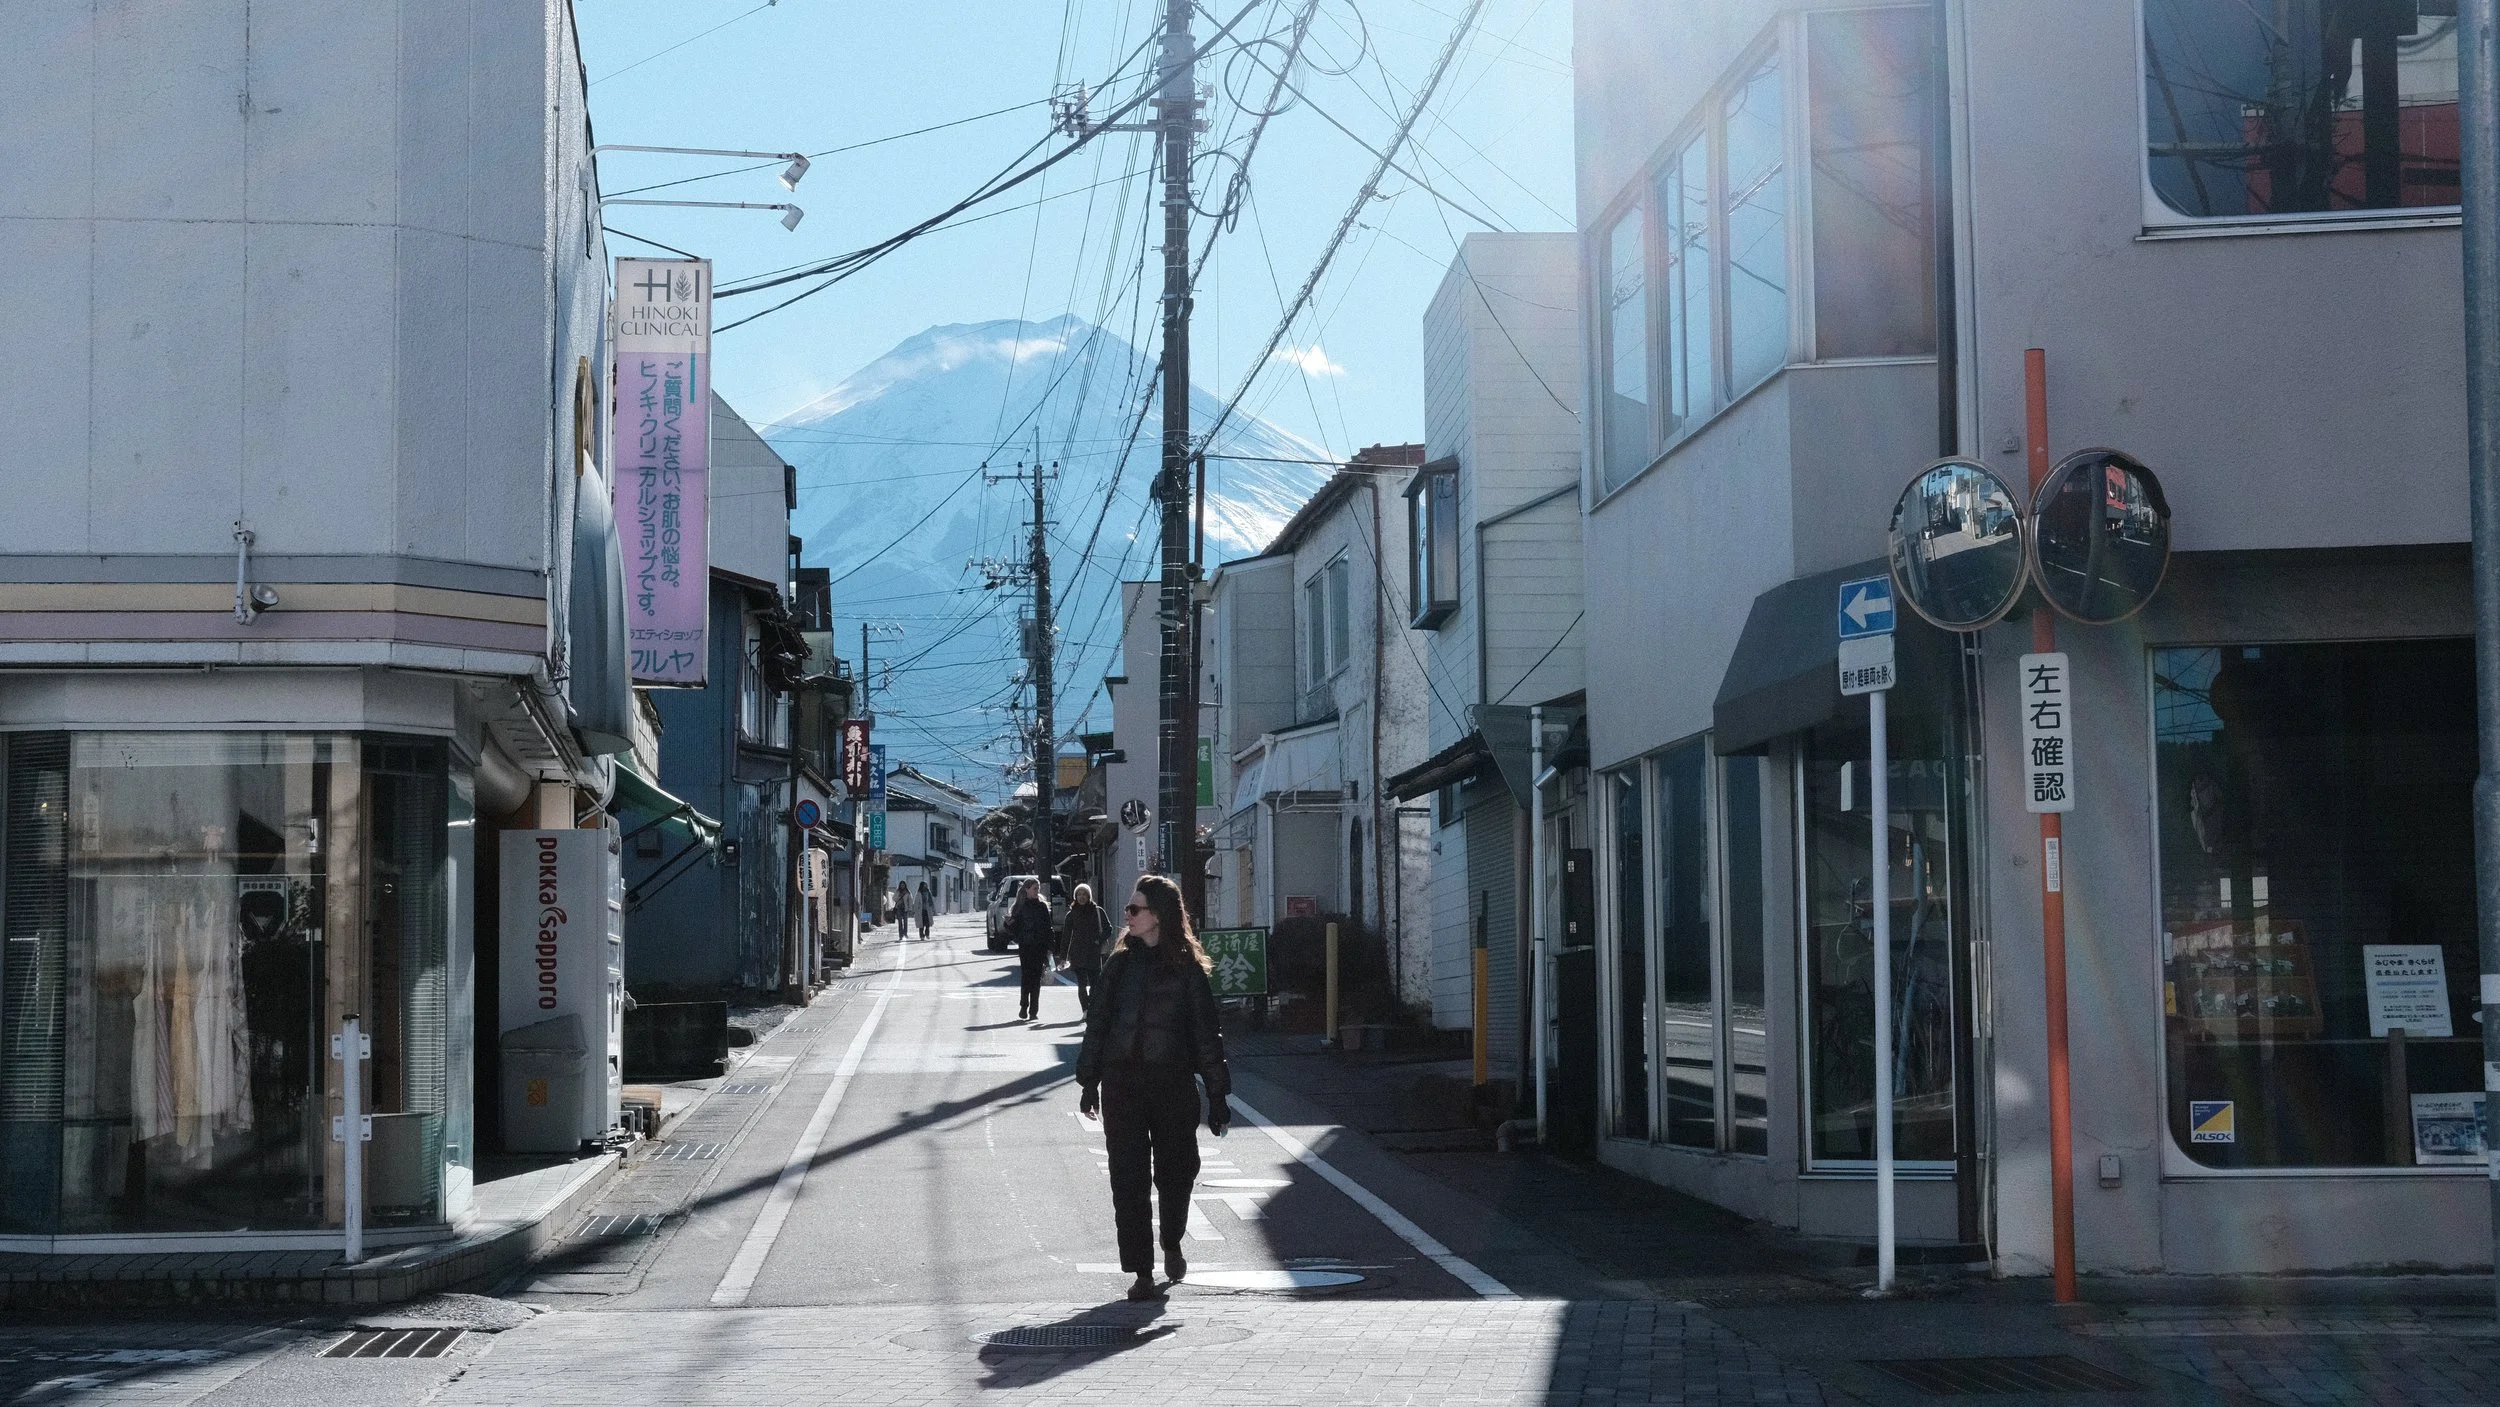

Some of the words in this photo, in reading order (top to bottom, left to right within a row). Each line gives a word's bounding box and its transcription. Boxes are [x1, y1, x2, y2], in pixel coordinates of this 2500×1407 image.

[620, 320, 703, 337] CLINICAL
[632, 305, 699, 321] HINOKI
[637, 360, 658, 617] ヒノキ・クリニカルショップです。
[661, 360, 683, 588] ご質問ください、お肌の悩み。
[631, 649, 695, 674] フルヤ
[2028, 664, 2066, 802] 左右確認
[535, 836, 558, 905] pokka
[535, 910, 558, 1010] sapporo
[1206, 933, 1260, 953] 居酒屋
[1216, 953, 1256, 991] 鈴
[2194, 1132, 2232, 1141] ALSOK
